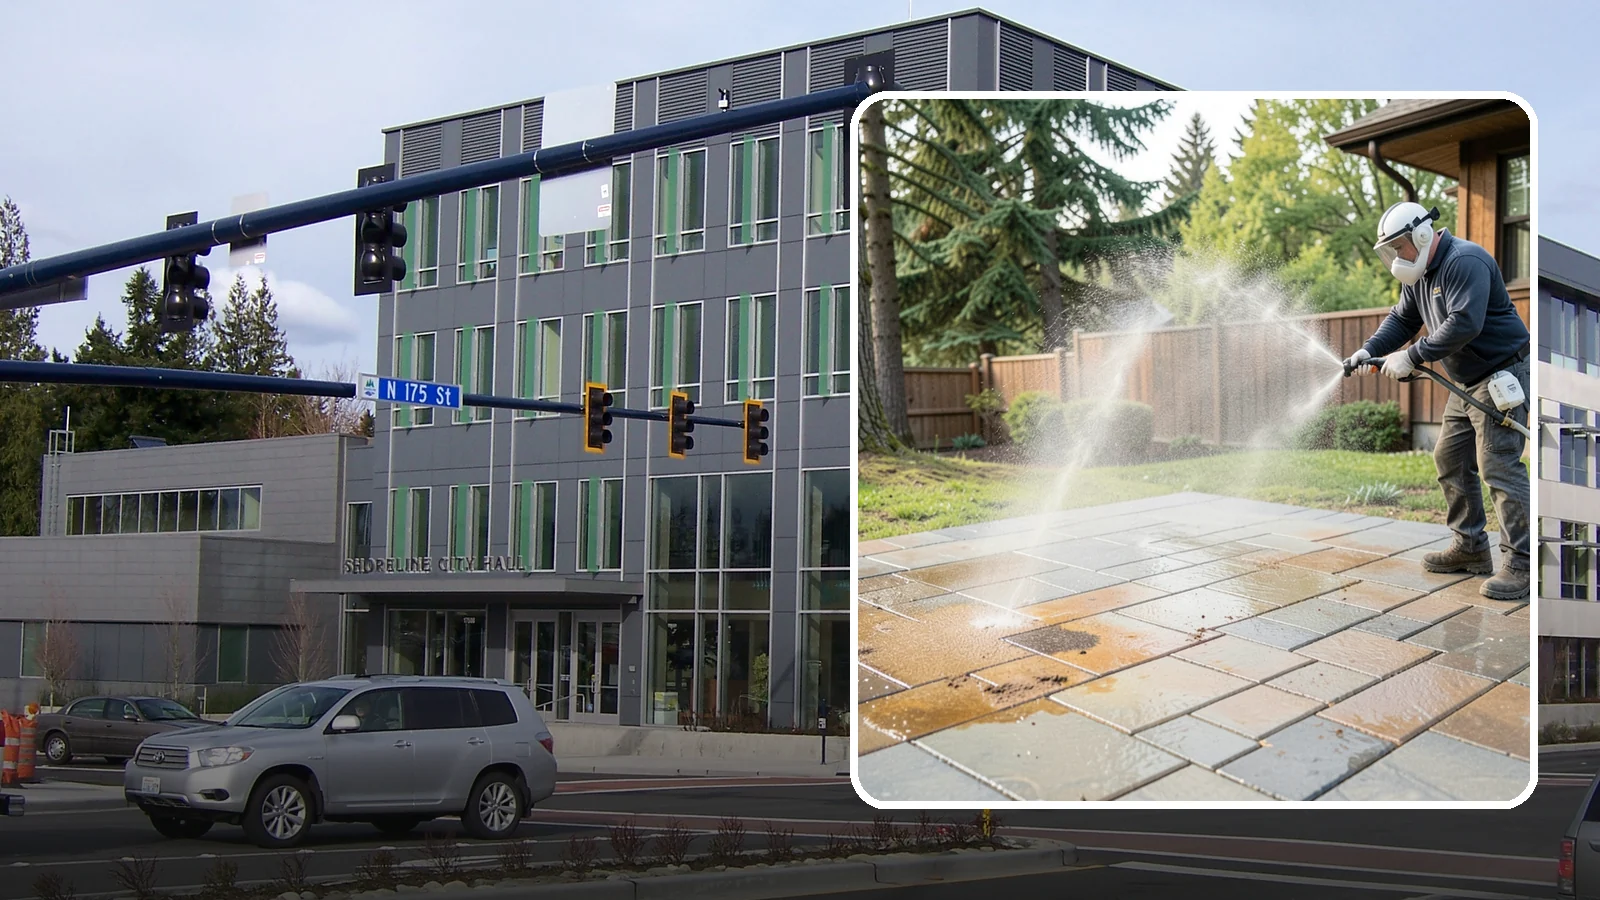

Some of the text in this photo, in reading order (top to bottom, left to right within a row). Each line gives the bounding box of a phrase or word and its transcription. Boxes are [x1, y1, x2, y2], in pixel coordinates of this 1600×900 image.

[387, 380, 451, 406] N 175 St
[344, 555, 526, 574] SHORELINE CITY HALL
